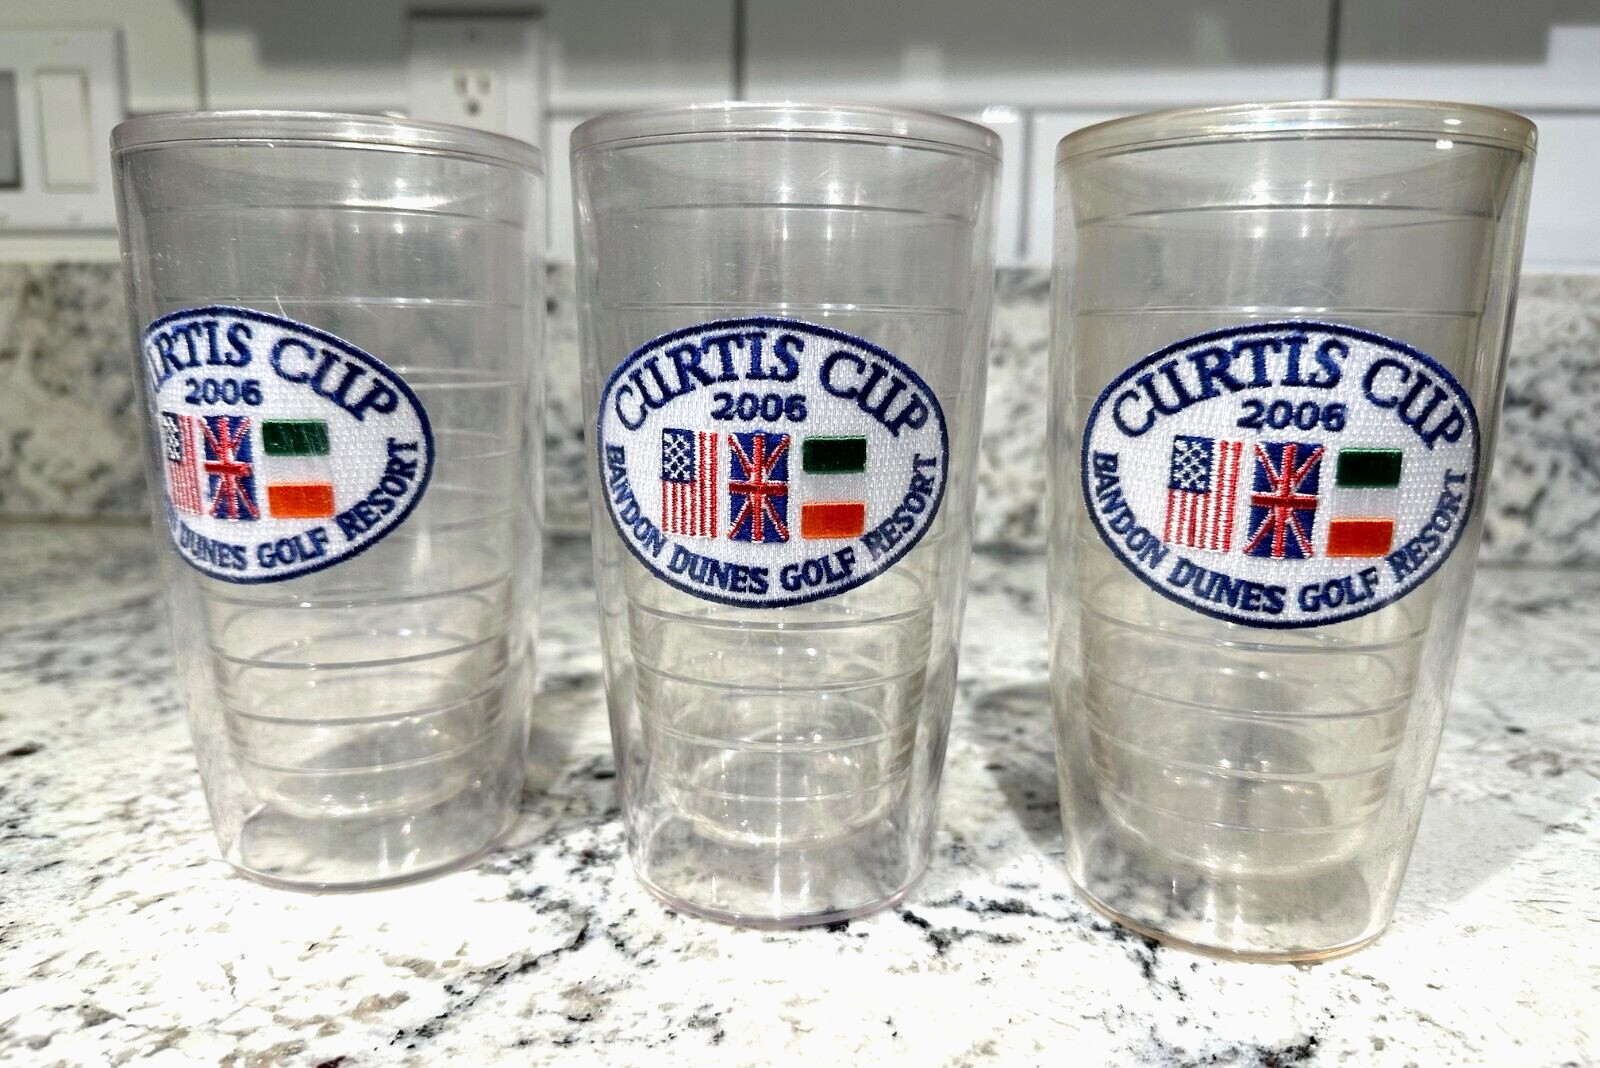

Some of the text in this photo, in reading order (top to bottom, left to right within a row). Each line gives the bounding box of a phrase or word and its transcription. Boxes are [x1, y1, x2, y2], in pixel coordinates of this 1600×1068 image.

[185, 378, 263, 406] 2006
[272, 338, 399, 422] CUP
[615, 332, 929, 437] CURTIS CUP
[711, 392, 807, 422] 2006
[1112, 336, 1465, 449] CURTIS CUP
[1237, 399, 1346, 432] 2006
[256, 526, 329, 568] GOLF
[333, 437, 418, 541] RESORT
[605, 442, 936, 594] BANDON DUNES GOLF RESORT
[1093, 449, 1466, 614] BANDON DUNES GOLF RESORT
